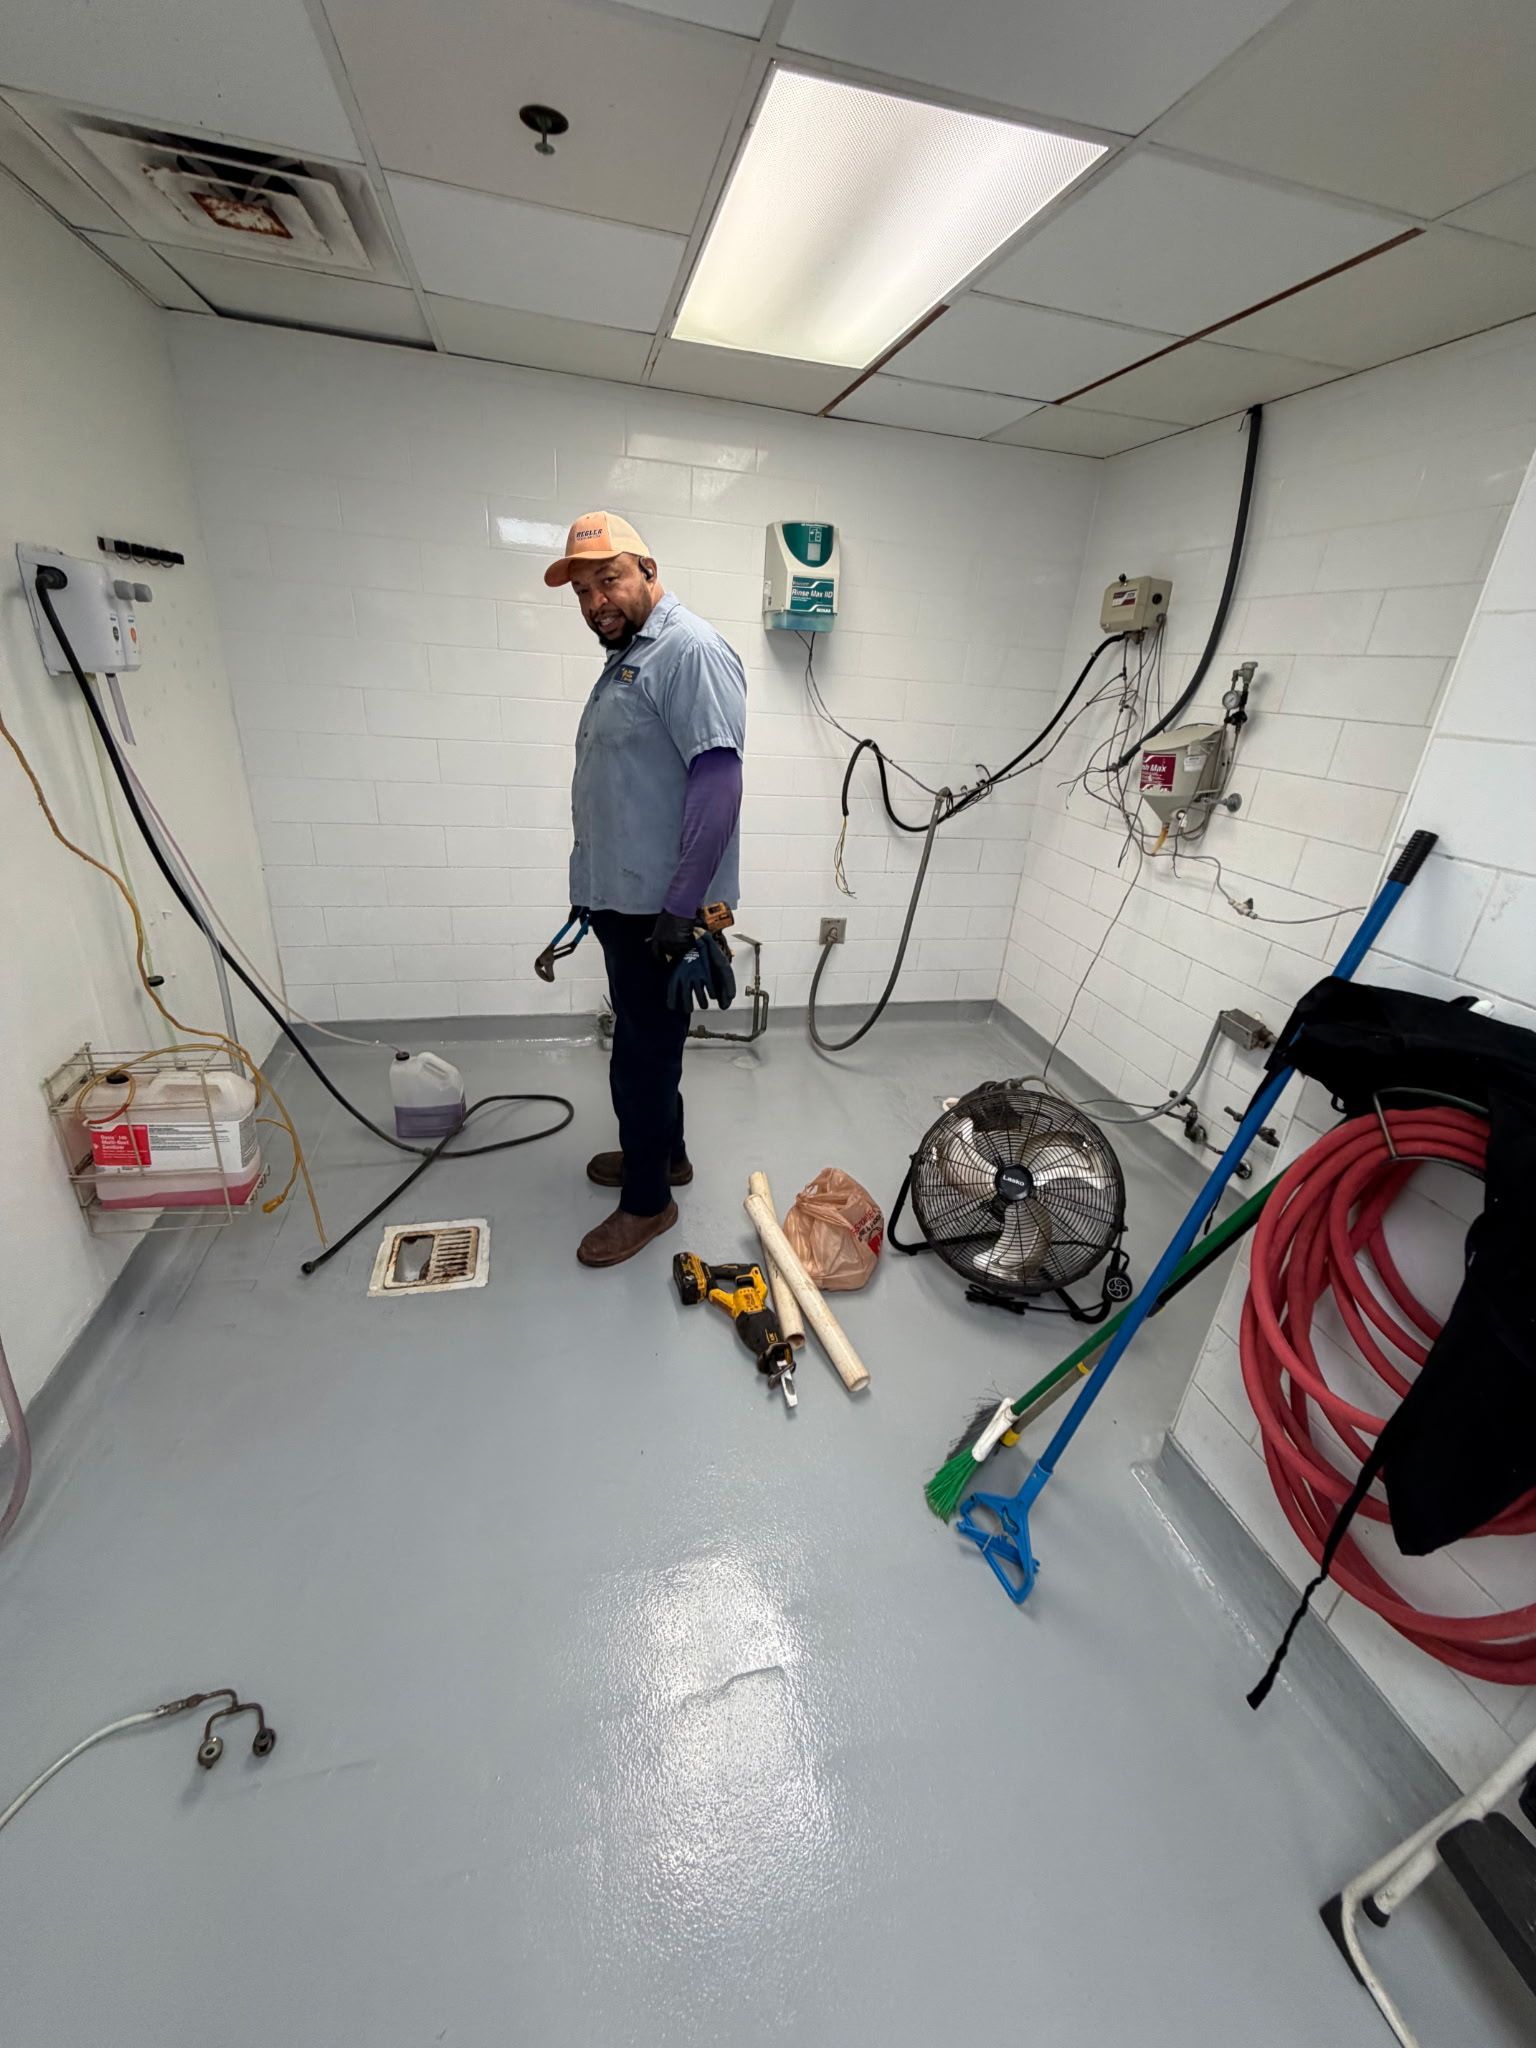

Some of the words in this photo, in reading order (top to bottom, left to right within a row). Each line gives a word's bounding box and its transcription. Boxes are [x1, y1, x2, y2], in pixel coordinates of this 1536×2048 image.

[792, 588, 810, 597] Rinse
[811, 589, 823, 598] Max
[1150, 764, 1168, 773] Max
[1002, 1174, 1025, 1187] Lasko
